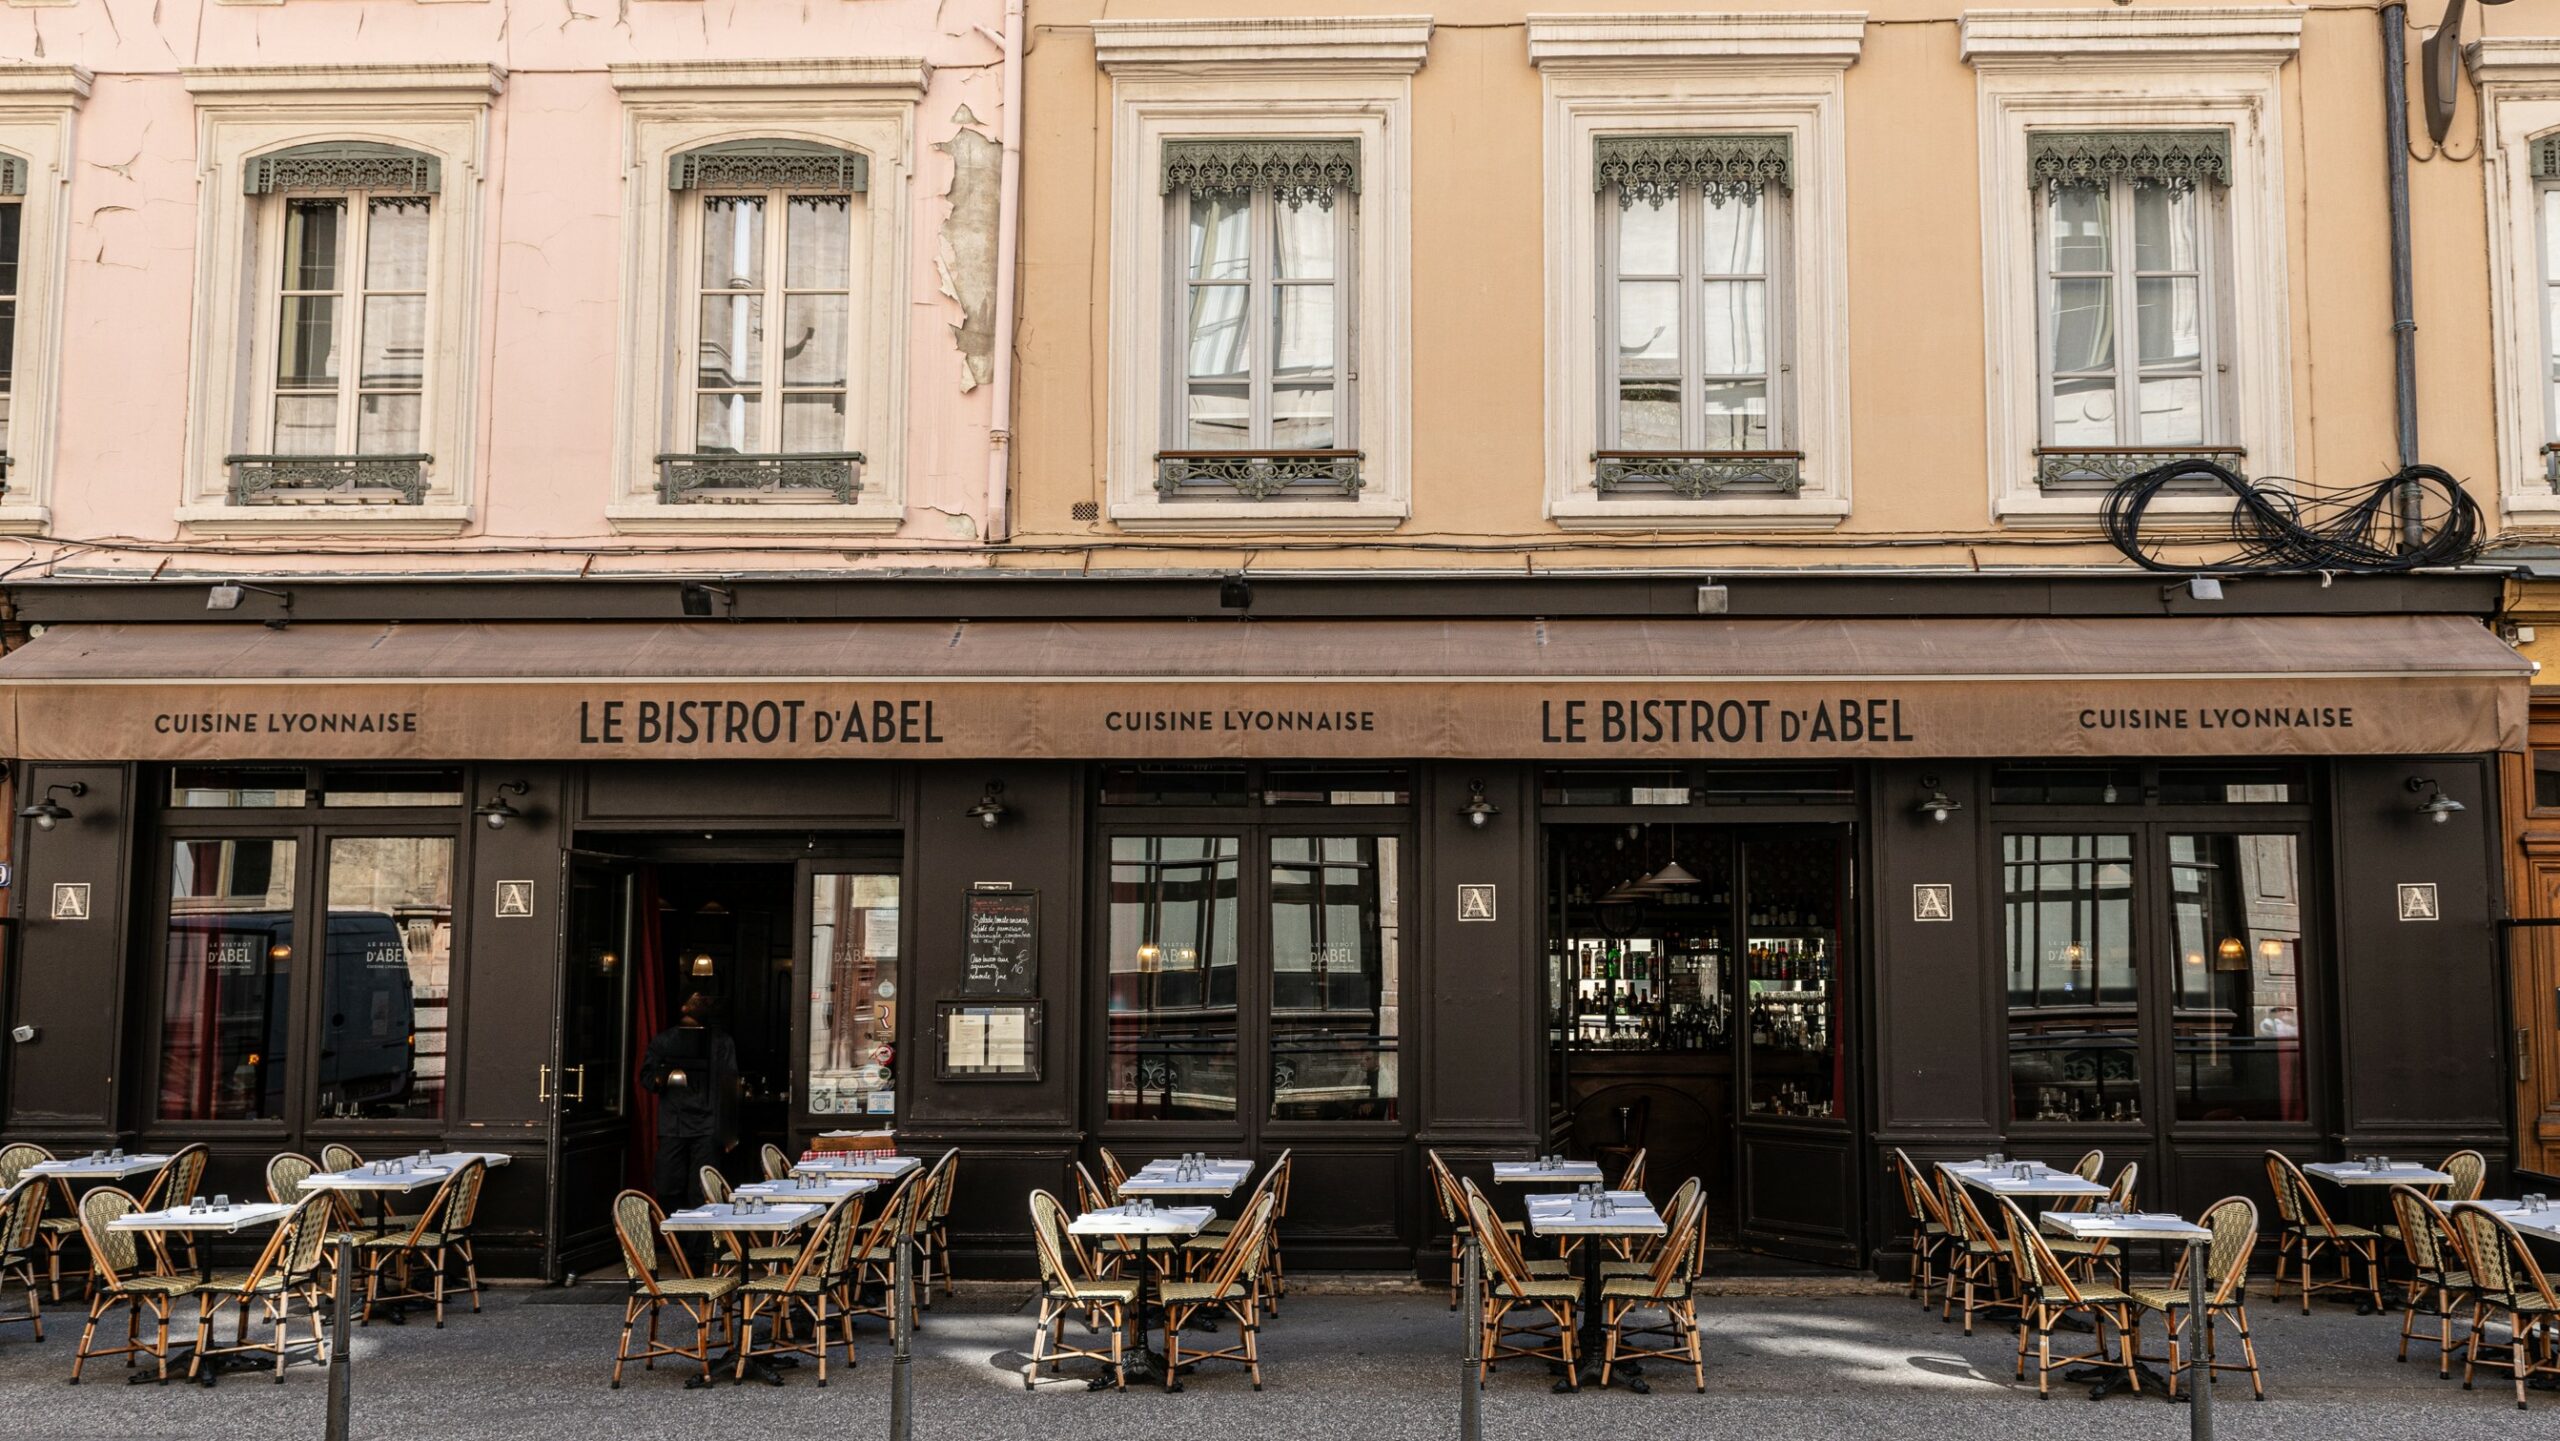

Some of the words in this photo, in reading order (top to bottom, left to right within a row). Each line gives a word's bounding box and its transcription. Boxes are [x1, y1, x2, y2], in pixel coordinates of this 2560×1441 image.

[154, 713, 258, 734] CUISINE
[268, 712, 417, 733] LYONNAISE
[580, 700, 624, 744] LE
[638, 700, 806, 744] BISTROT
[814, 700, 944, 744] D'ABEL
[1105, 711, 1213, 732] CUISINE
[1224, 710, 1374, 732] LYONNAISE
[1542, 700, 1587, 743] LE
[1602, 699, 1771, 743] BISTROT
[1780, 699, 1914, 743] D'ABEL
[2079, 709, 2188, 730] CUISINE
[2199, 707, 2353, 729] LYONNAISE
[56, 887, 84, 916] A
[500, 884, 528, 913] A
[1462, 888, 1491, 917] A
[1918, 888, 1947, 917] A
[2403, 887, 2433, 917] A
[208, 948, 252, 963] D'ABEL
[1310, 948, 1354, 963] D'ABEL
